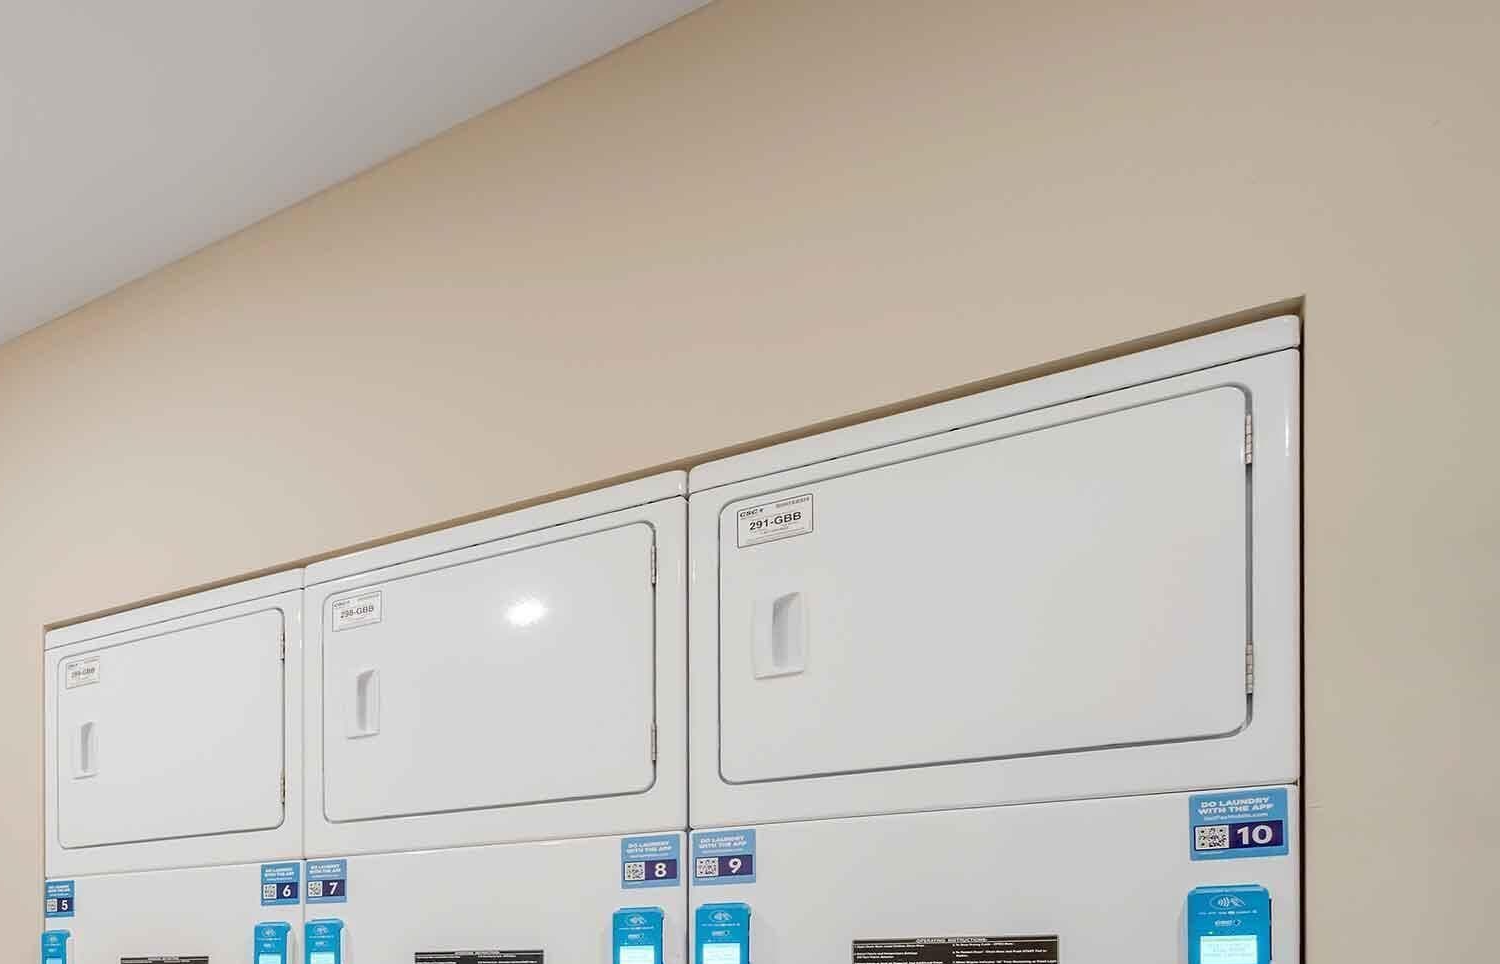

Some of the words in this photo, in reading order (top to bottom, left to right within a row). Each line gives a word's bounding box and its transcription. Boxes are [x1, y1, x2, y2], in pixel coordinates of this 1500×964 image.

[750, 511, 802, 531] 291-GBB
[1201, 800, 1217, 808] DO
[1219, 796, 1270, 807] LAUNDRY
[1197, 807, 1227, 816] WITH
[1228, 805, 1250, 813] THE
[1252, 803, 1275, 811] APP
[1237, 824, 1273, 845] 10
[654, 863, 667, 877] 8
[728, 858, 742, 874] 9
[282, 884, 291, 897] 6
[329, 882, 338, 895] 7
[61, 900, 68, 911] 5
